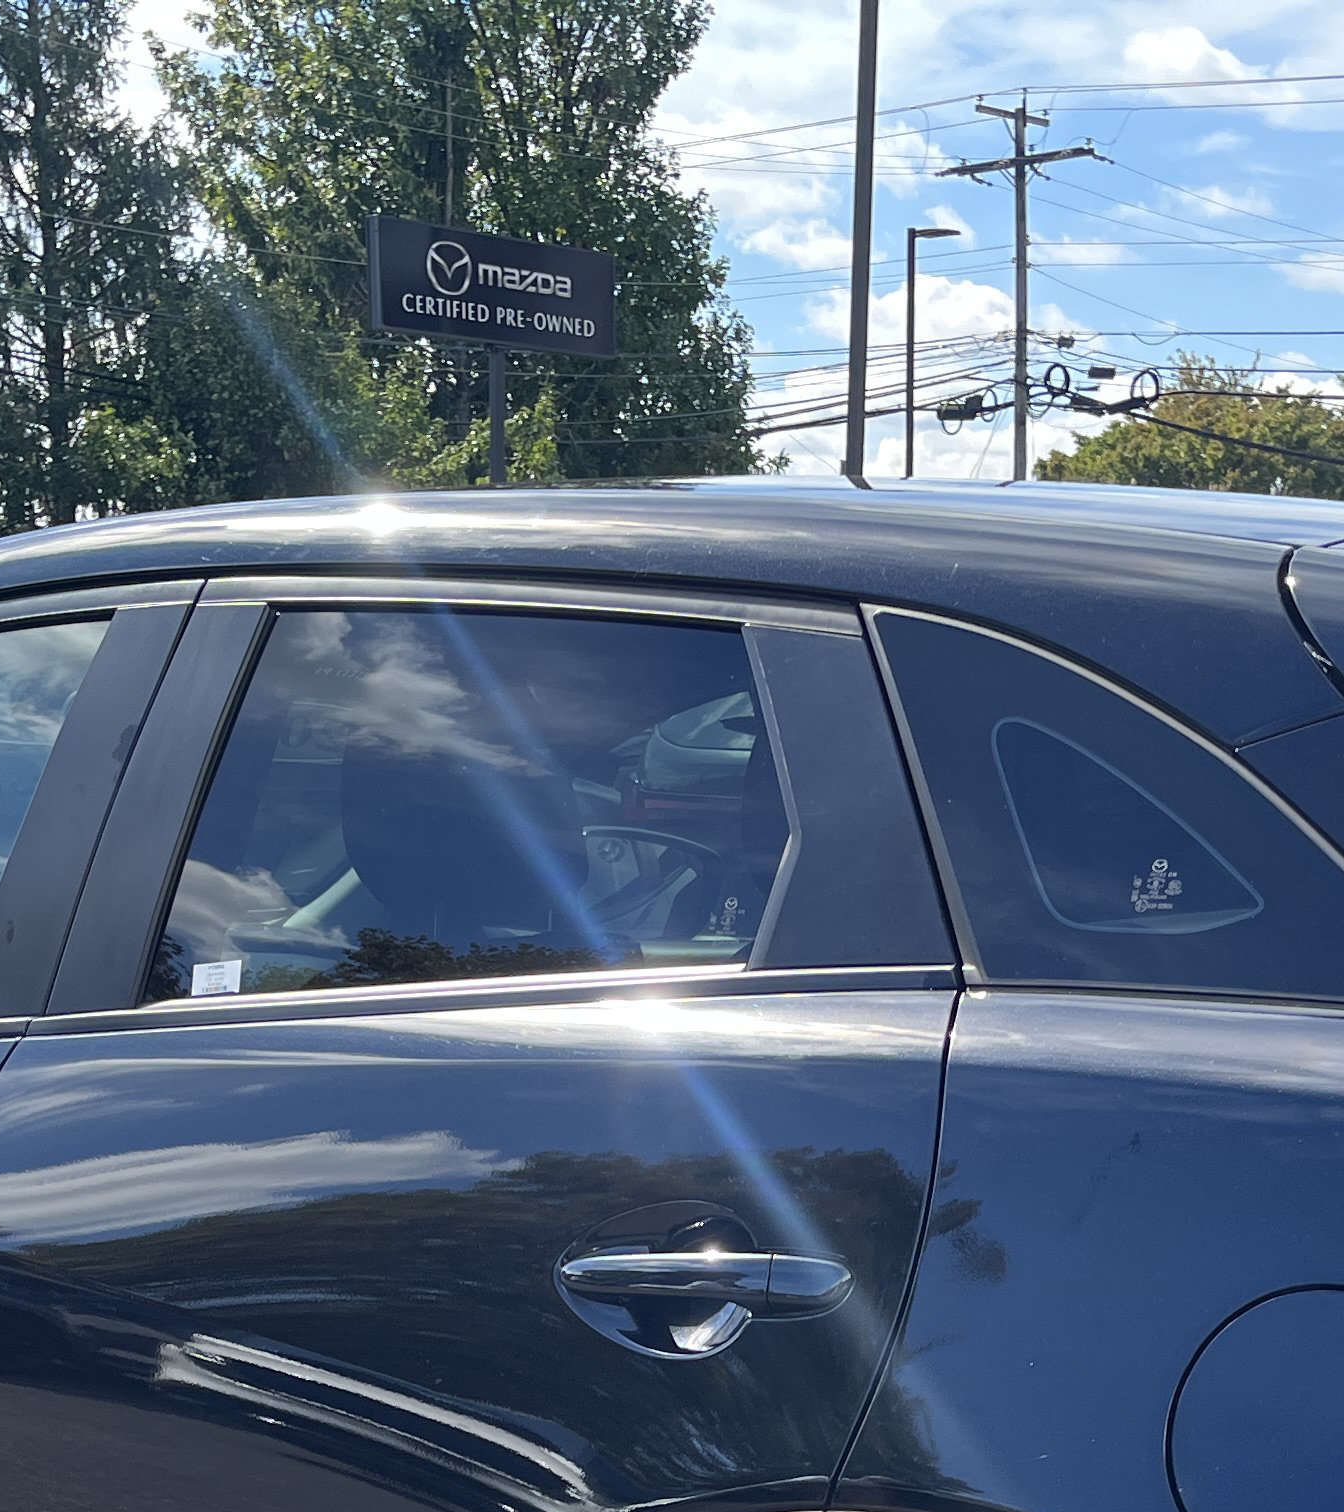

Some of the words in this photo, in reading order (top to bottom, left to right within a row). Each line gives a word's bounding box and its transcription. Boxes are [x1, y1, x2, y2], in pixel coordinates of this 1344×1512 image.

[477, 262, 572, 299] mazda
[401, 293, 490, 323] CERTIFIED
[496, 307, 596, 338] PRE-OWNED
